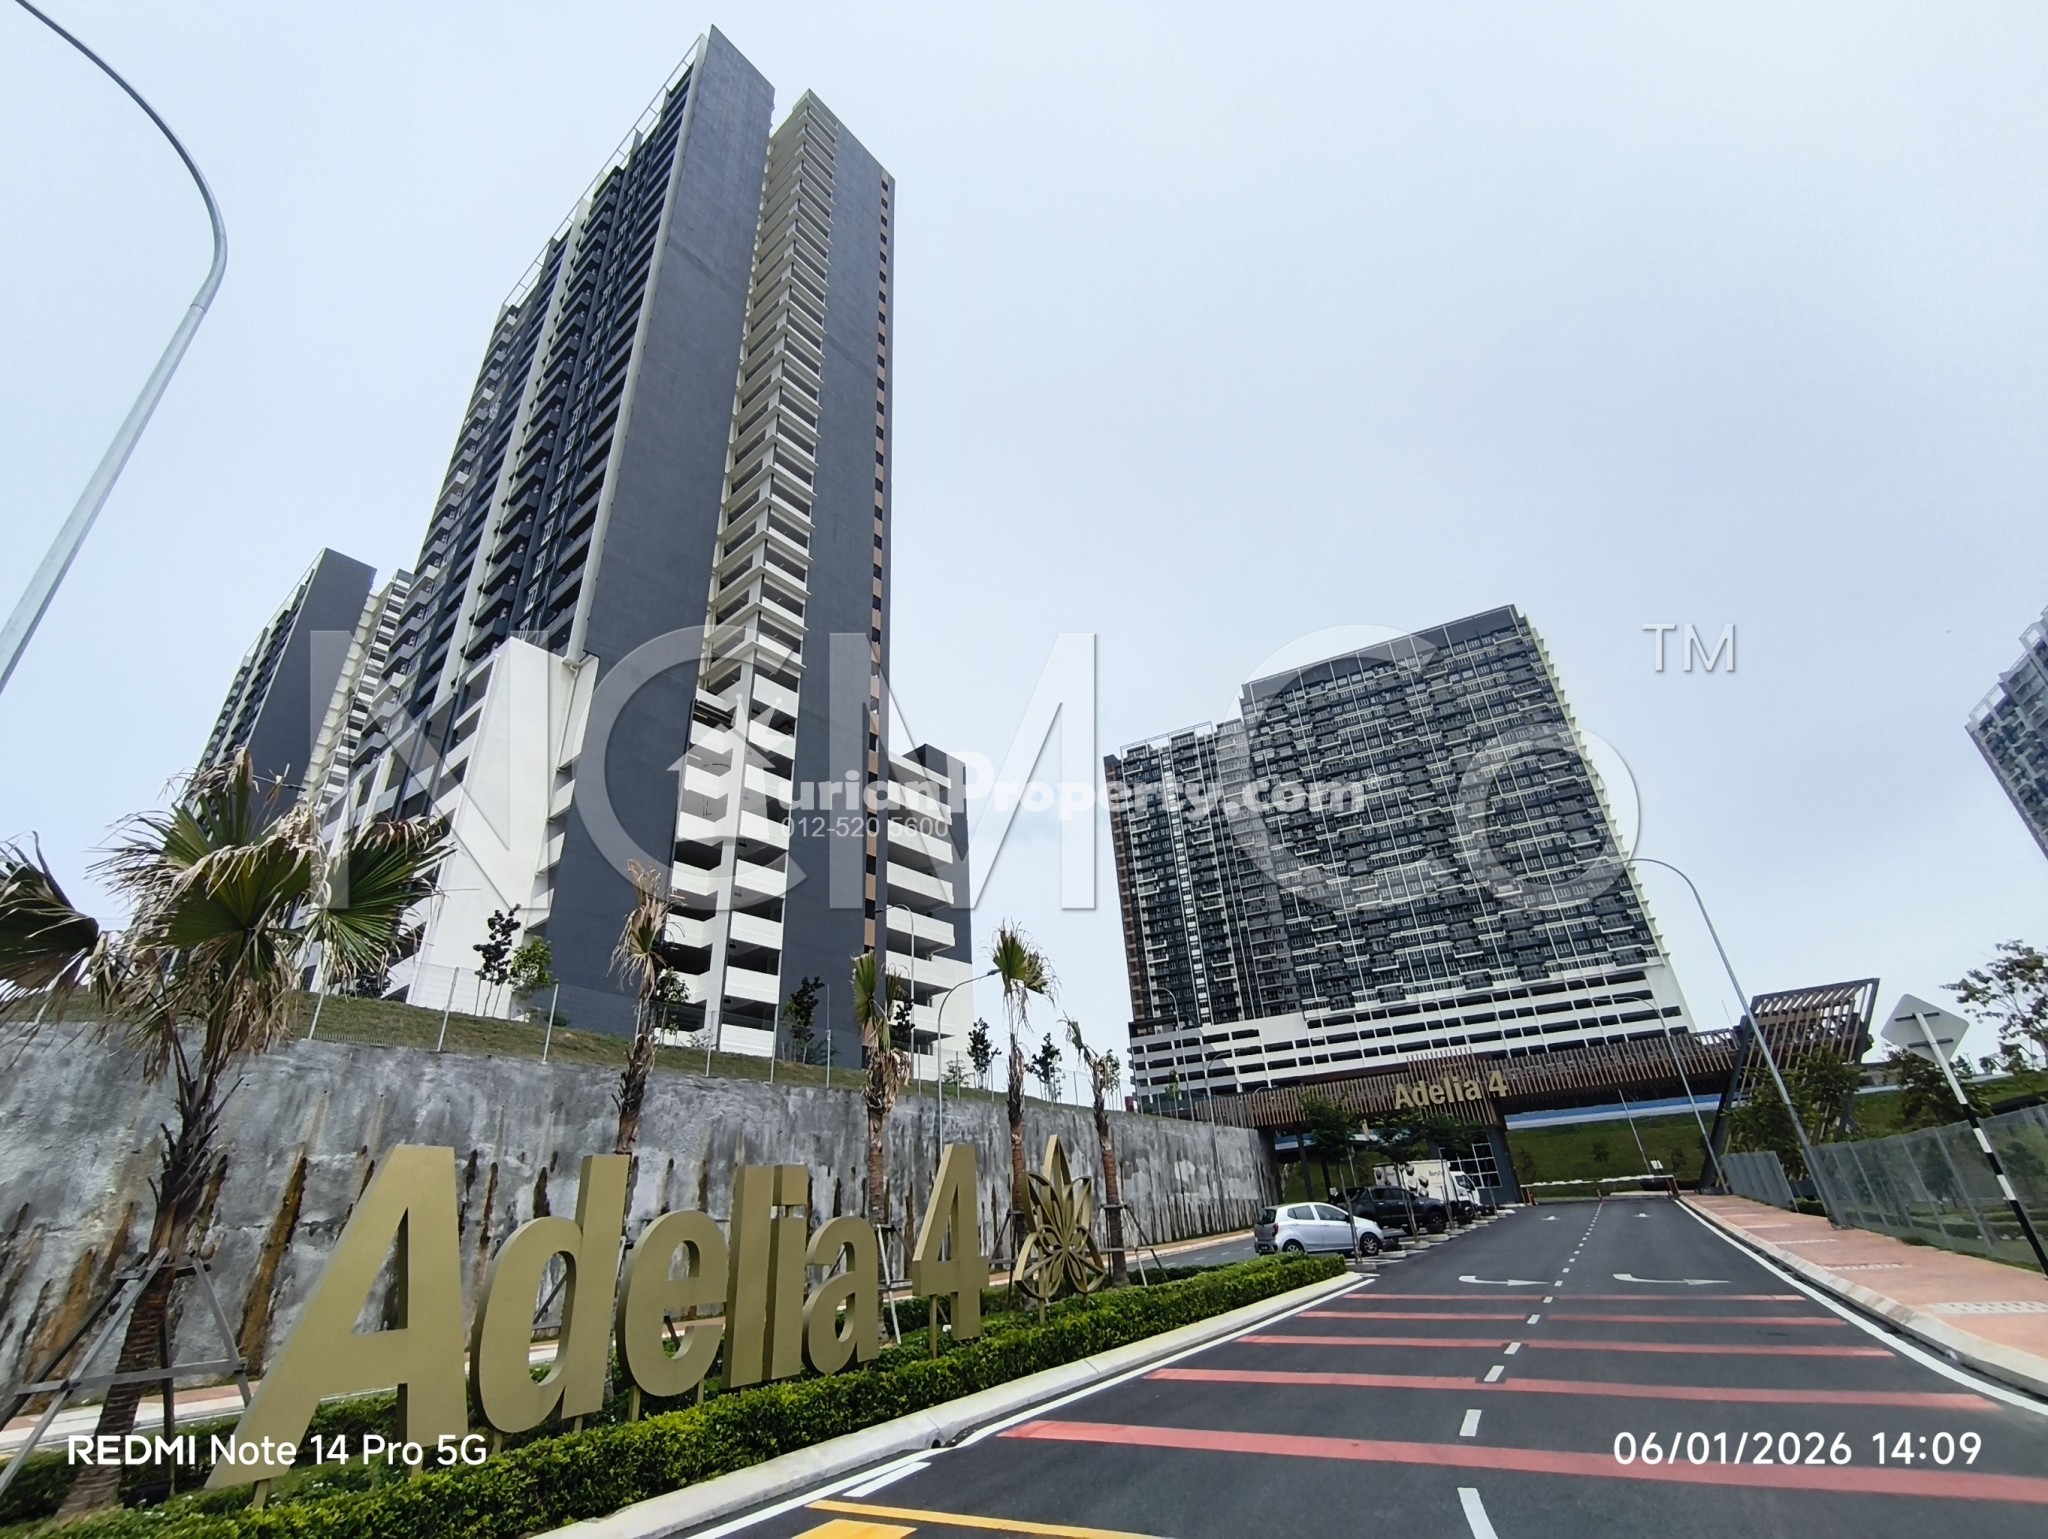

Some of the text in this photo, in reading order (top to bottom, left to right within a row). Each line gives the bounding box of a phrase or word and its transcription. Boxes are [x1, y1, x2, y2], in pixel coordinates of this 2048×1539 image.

[1394, 1070, 1508, 1109] Adelia 4
[204, 1143, 989, 1490] Adelia 4
